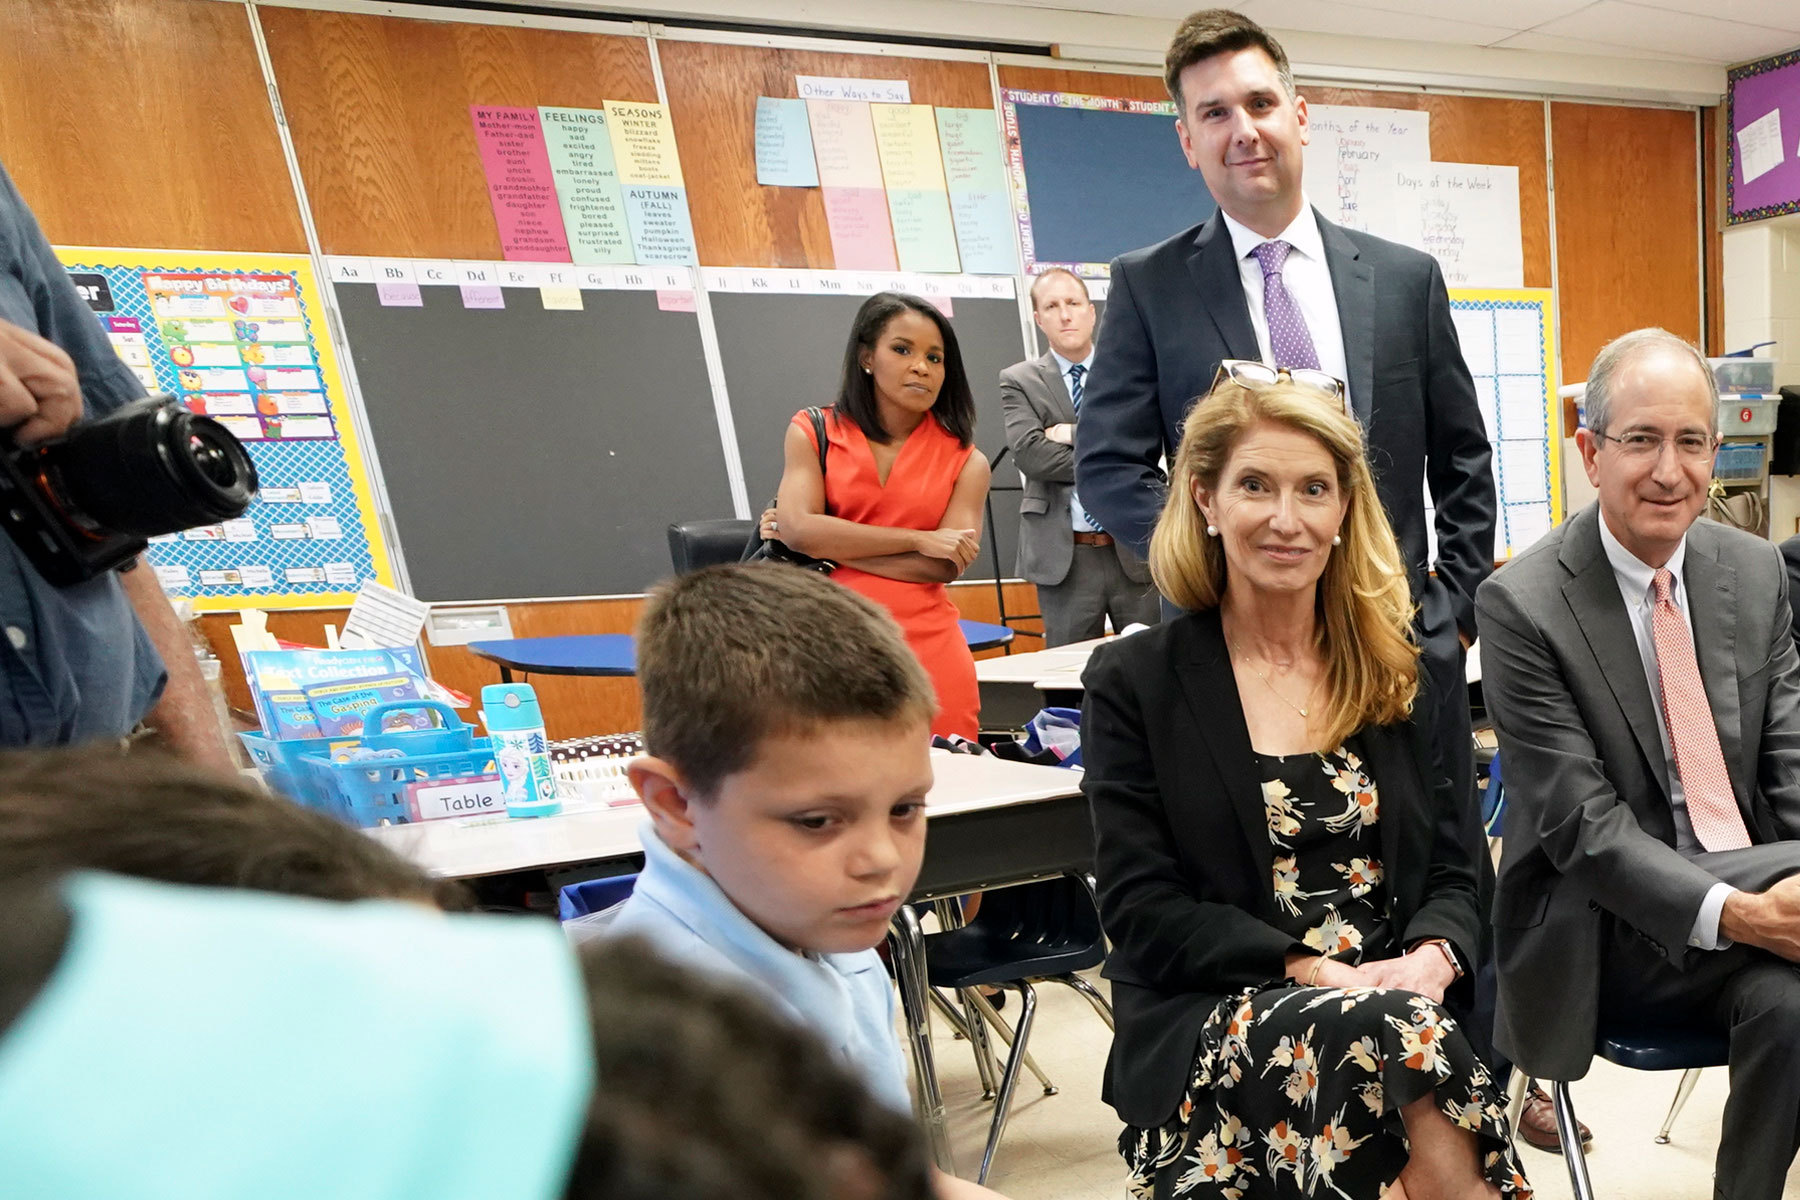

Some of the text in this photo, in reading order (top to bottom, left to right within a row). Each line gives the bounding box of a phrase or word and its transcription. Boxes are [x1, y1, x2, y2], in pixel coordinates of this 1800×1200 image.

[803, 83, 905, 102] Other Ways to Say
[1008, 90, 1051, 104] STUDENT
[1052, 93, 1064, 105] OF
[1089, 95, 1119, 109] MONTH
[1129, 101, 1169, 113] STUDENT
[477, 111, 536, 121] MY FAMILY
[611, 106, 662, 119] SEASONS
[545, 112, 605, 125] FEELINGS
[479, 122, 536, 130] Mother-mom
[621, 119, 657, 128] WINTER
[1350, 119, 1409, 136] of the Year
[561, 125, 589, 134] happy
[484, 130, 535, 139] Father-dad
[568, 152, 594, 160] angry
[1338, 145, 1380, 161] February
[556, 168, 614, 177] embarrassed
[573, 177, 600, 185] lonely
[1397, 172, 1492, 190] Days of the Week
[493, 184, 550, 192] grandmother
[497, 193, 550, 201] grandfather
[630, 190, 679, 200] AUTUMN
[569, 203, 615, 212] frightened
[640, 201, 672, 210] (FALL)
[578, 230, 620, 238] surprised
[644, 228, 680, 236] pumpkin
[578, 238, 623, 246] frustrated
[505, 245, 567, 253] granddaughter
[594, 247, 611, 255] silly
[638, 244, 691, 253] Thanksgiving
[340, 266, 359, 278] Aa
[385, 267, 404, 279] Bb
[426, 269, 443, 280] Cc
[467, 270, 487, 281] Dd
[588, 273, 603, 286] Gg
[625, 275, 643, 285] Hh
[148, 275, 291, 294] Happy Birthdays!
[751, 278, 842, 290] Kk Mm
[402, 652, 412, 665] 3
[307, 665, 388, 679] Collection
[317, 699, 332, 708] The
[333, 694, 350, 705] Case
[350, 692, 360, 701] of
[361, 690, 374, 699] the
[331, 697, 379, 714] Gasping
[440, 793, 493, 812] Table
